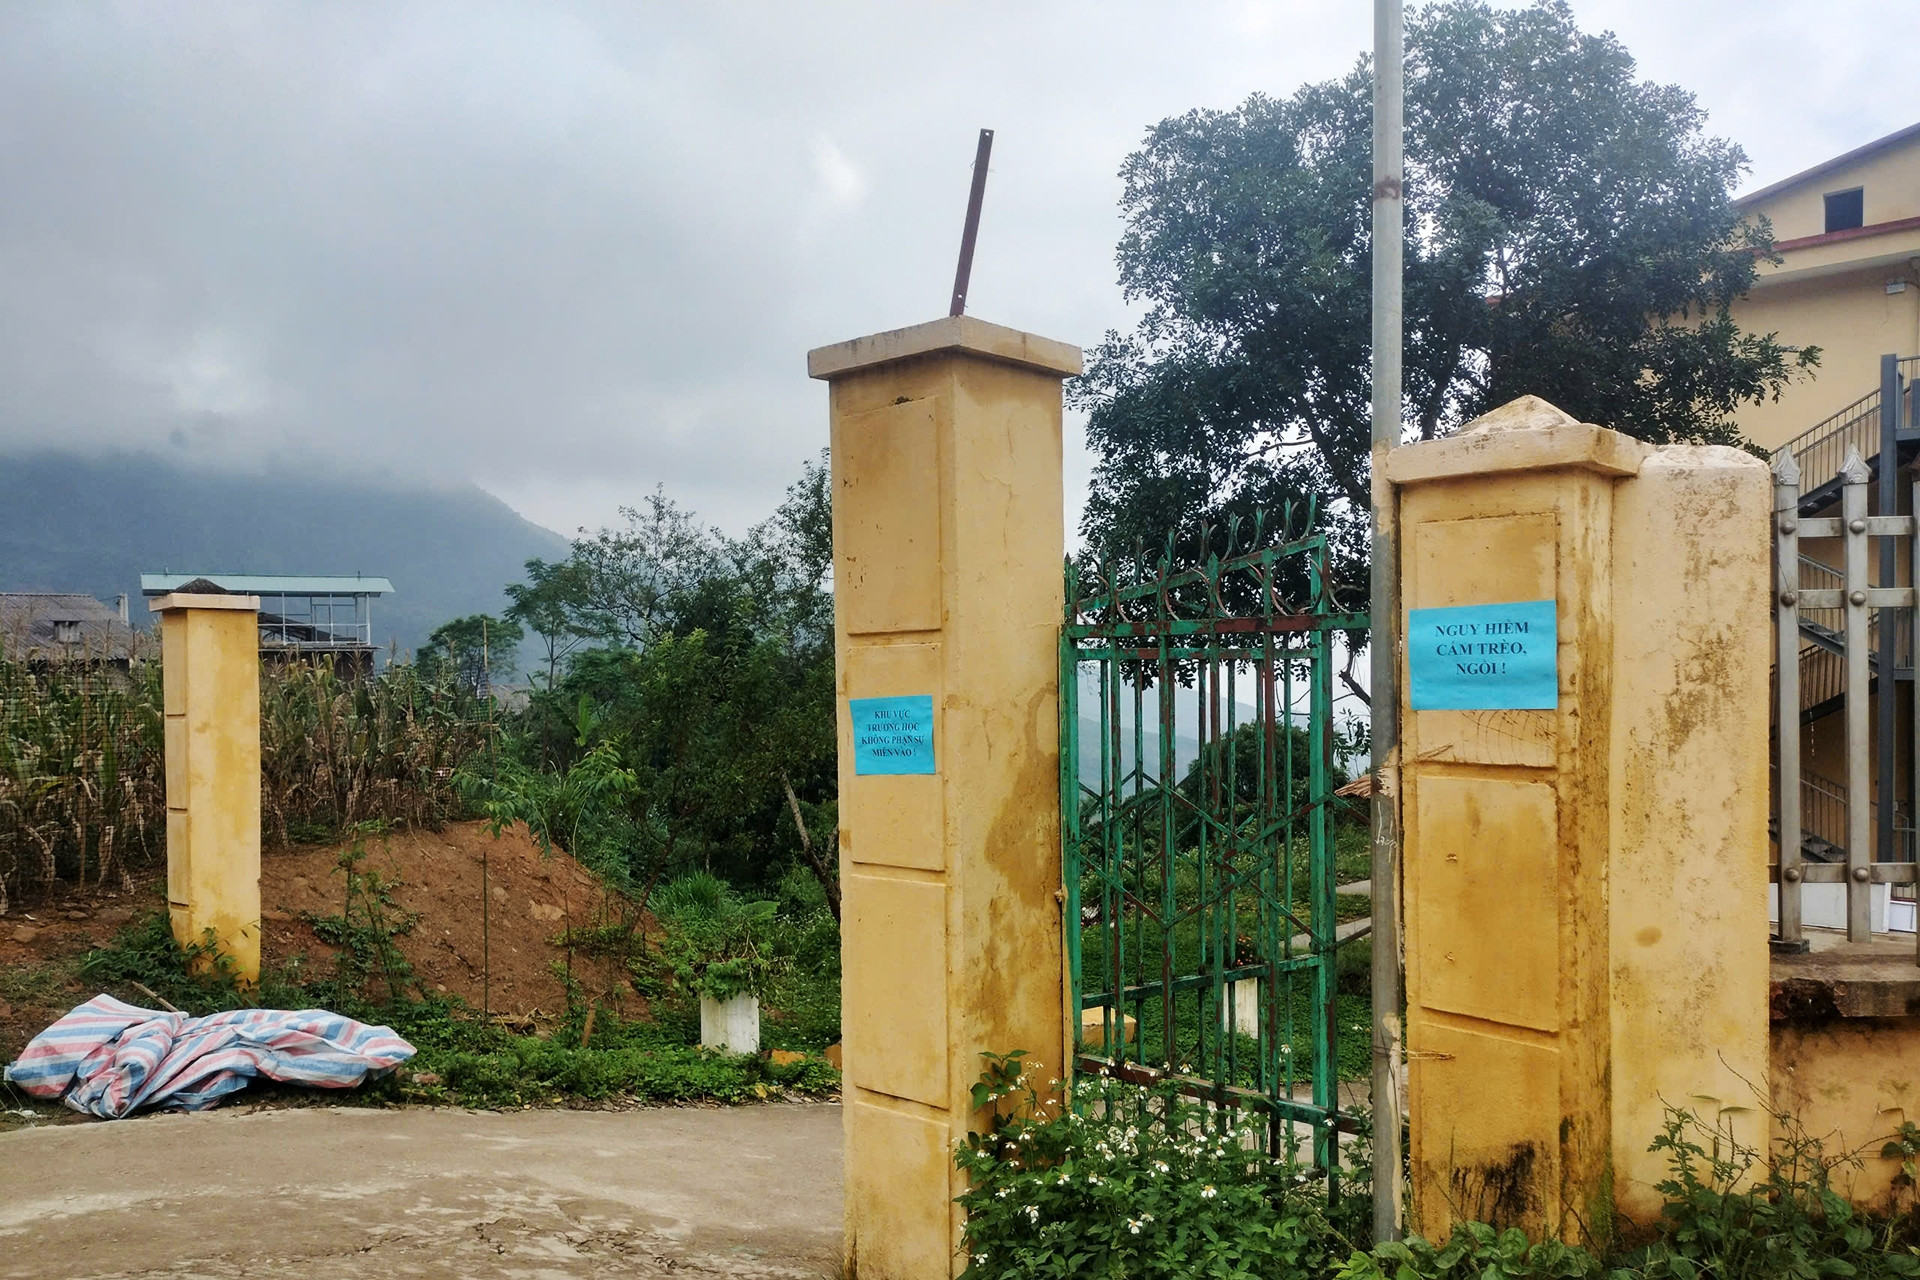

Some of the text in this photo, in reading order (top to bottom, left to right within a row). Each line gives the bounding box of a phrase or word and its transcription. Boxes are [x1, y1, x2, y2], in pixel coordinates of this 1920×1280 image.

[1435, 624, 1480, 637] NGUY
[1477, 639, 1527, 655] TRÈO,
[874, 710, 890, 719] KHU
